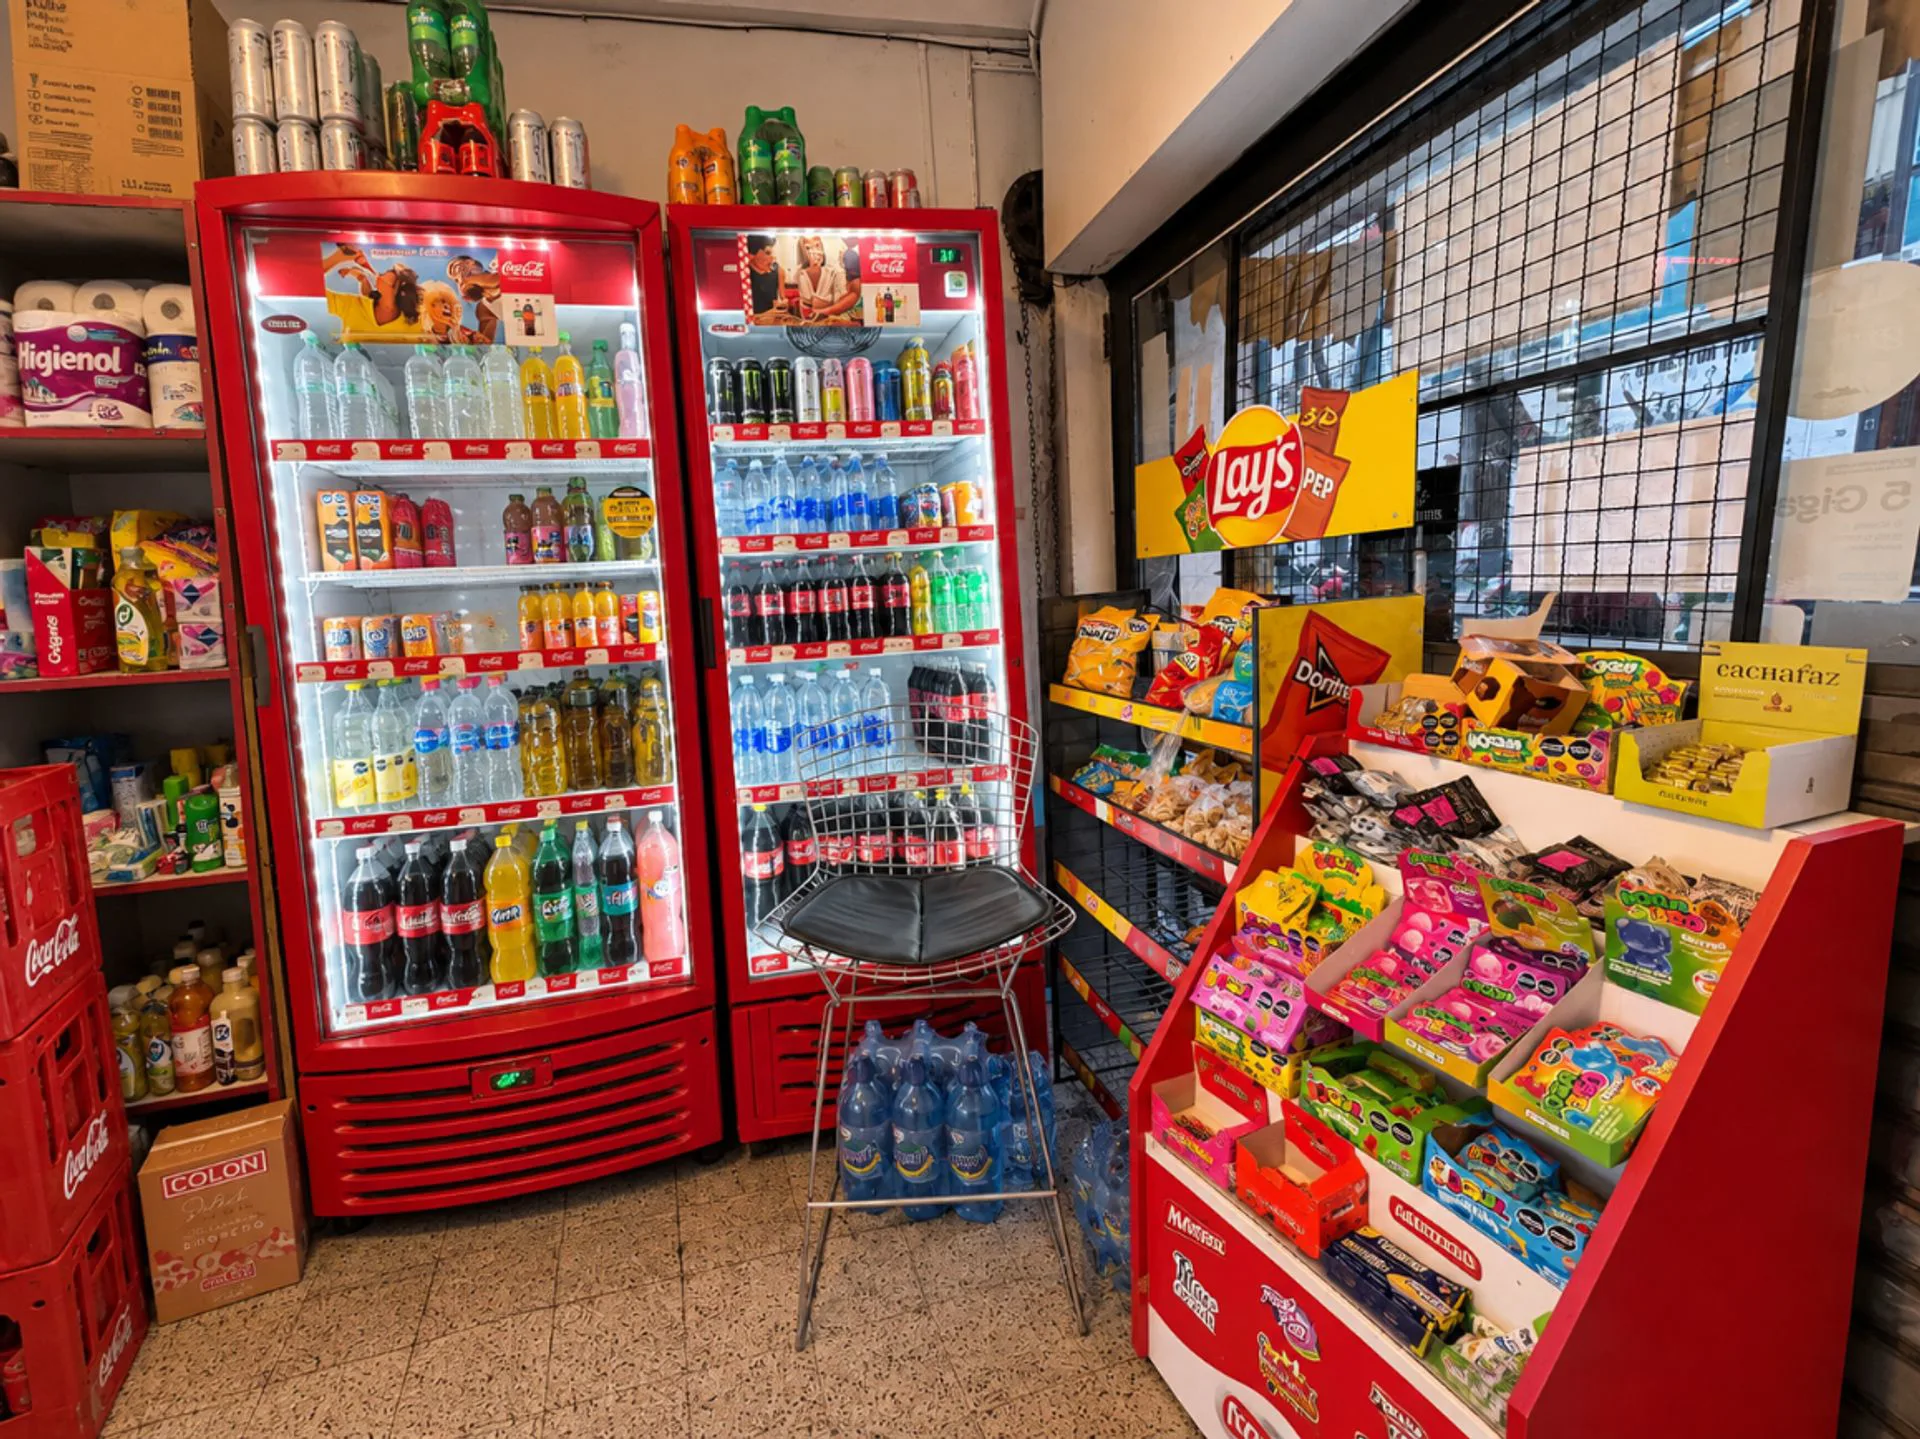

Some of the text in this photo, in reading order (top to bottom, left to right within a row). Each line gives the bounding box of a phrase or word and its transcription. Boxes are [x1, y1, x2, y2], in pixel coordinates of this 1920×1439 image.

[18, 341, 121, 377] Higienol
[1212, 434, 1297, 521] Lay's
[1302, 467, 1334, 499] PEP
[47, 615, 62, 664] Colgate
[25, 914, 80, 987] Coca-Cola
[170, 1155, 258, 1192] COLON
